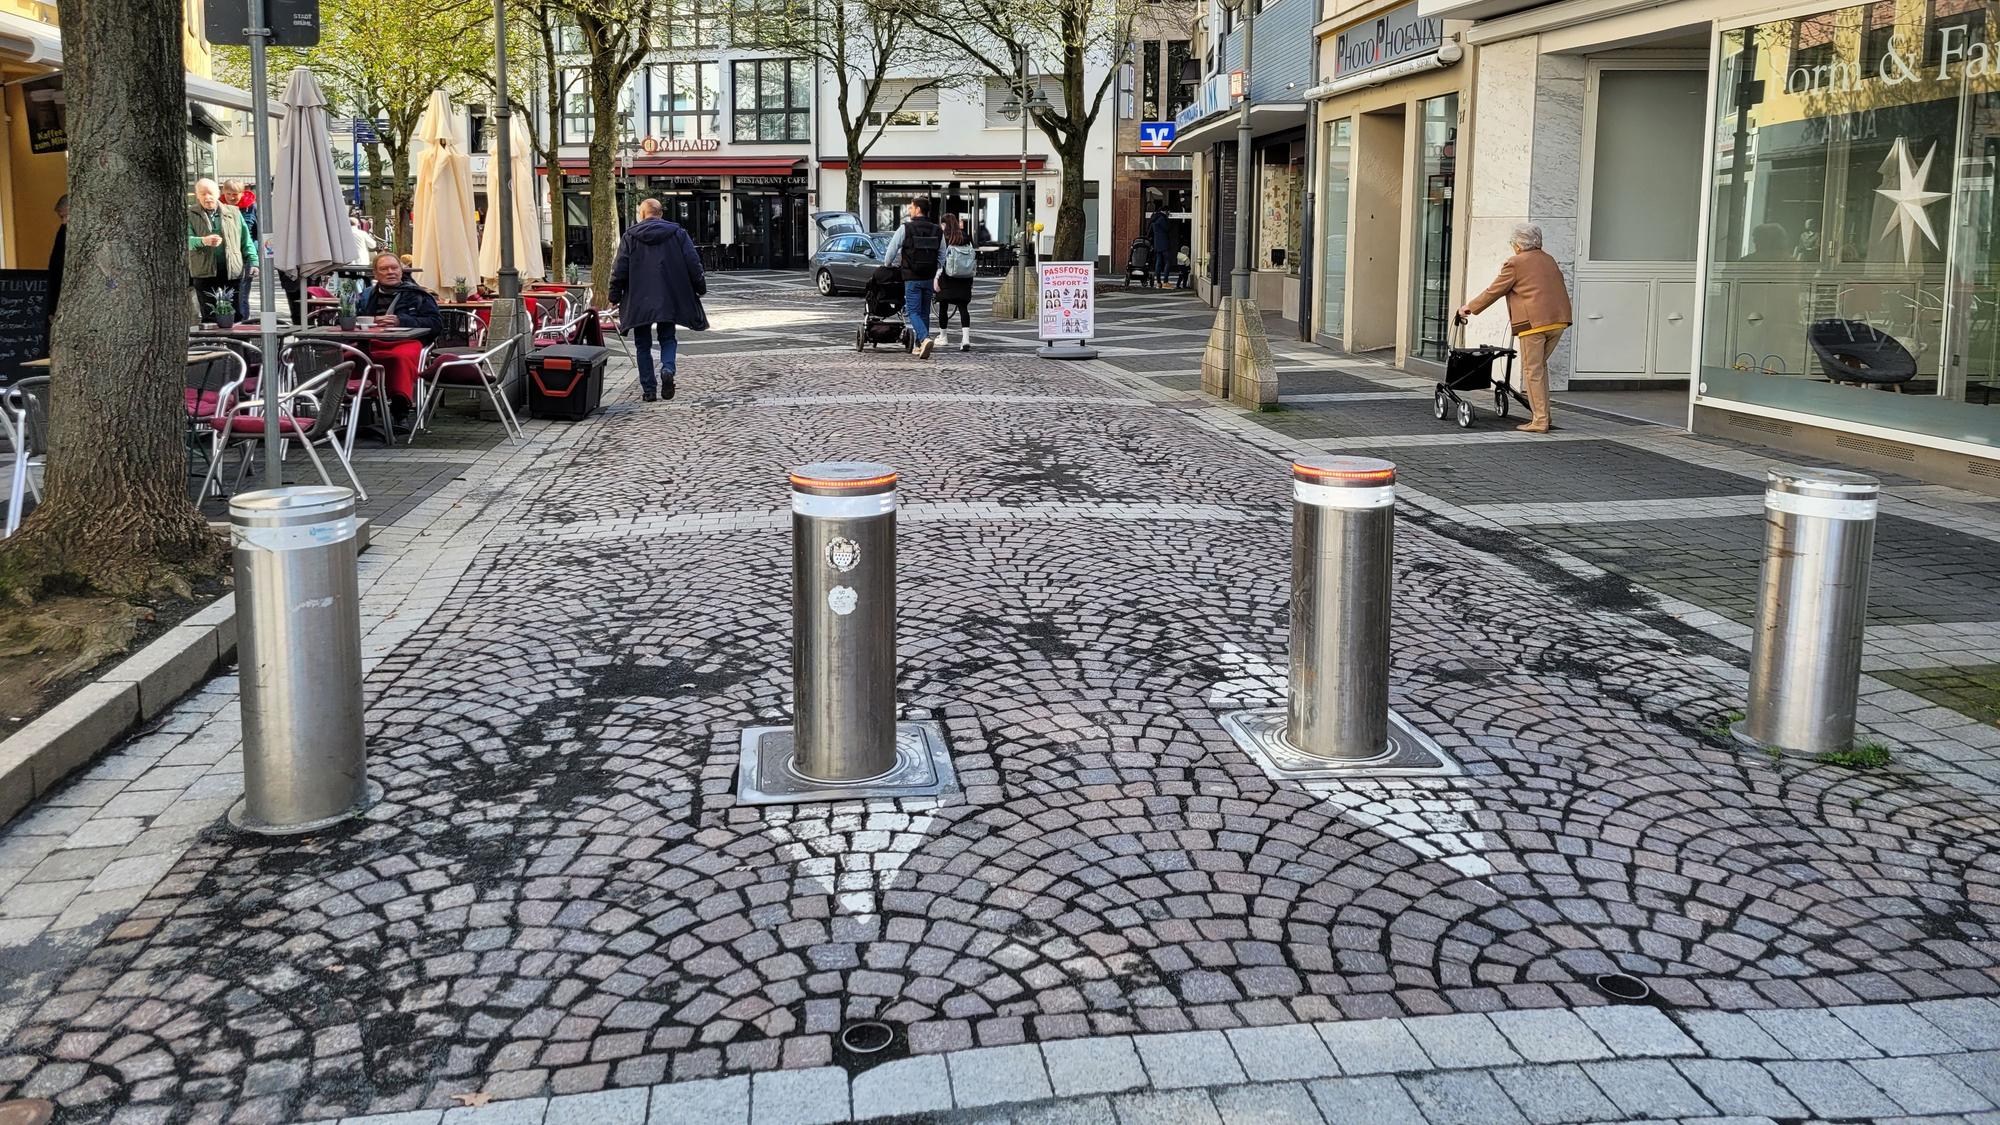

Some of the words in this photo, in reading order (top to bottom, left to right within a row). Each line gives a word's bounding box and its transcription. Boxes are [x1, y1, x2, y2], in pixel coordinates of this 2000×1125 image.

[1879, 33, 1922, 86] &
[740, 176, 783, 184] RESTAURANT
[1044, 266, 1089, 276] PASSFOTOS
